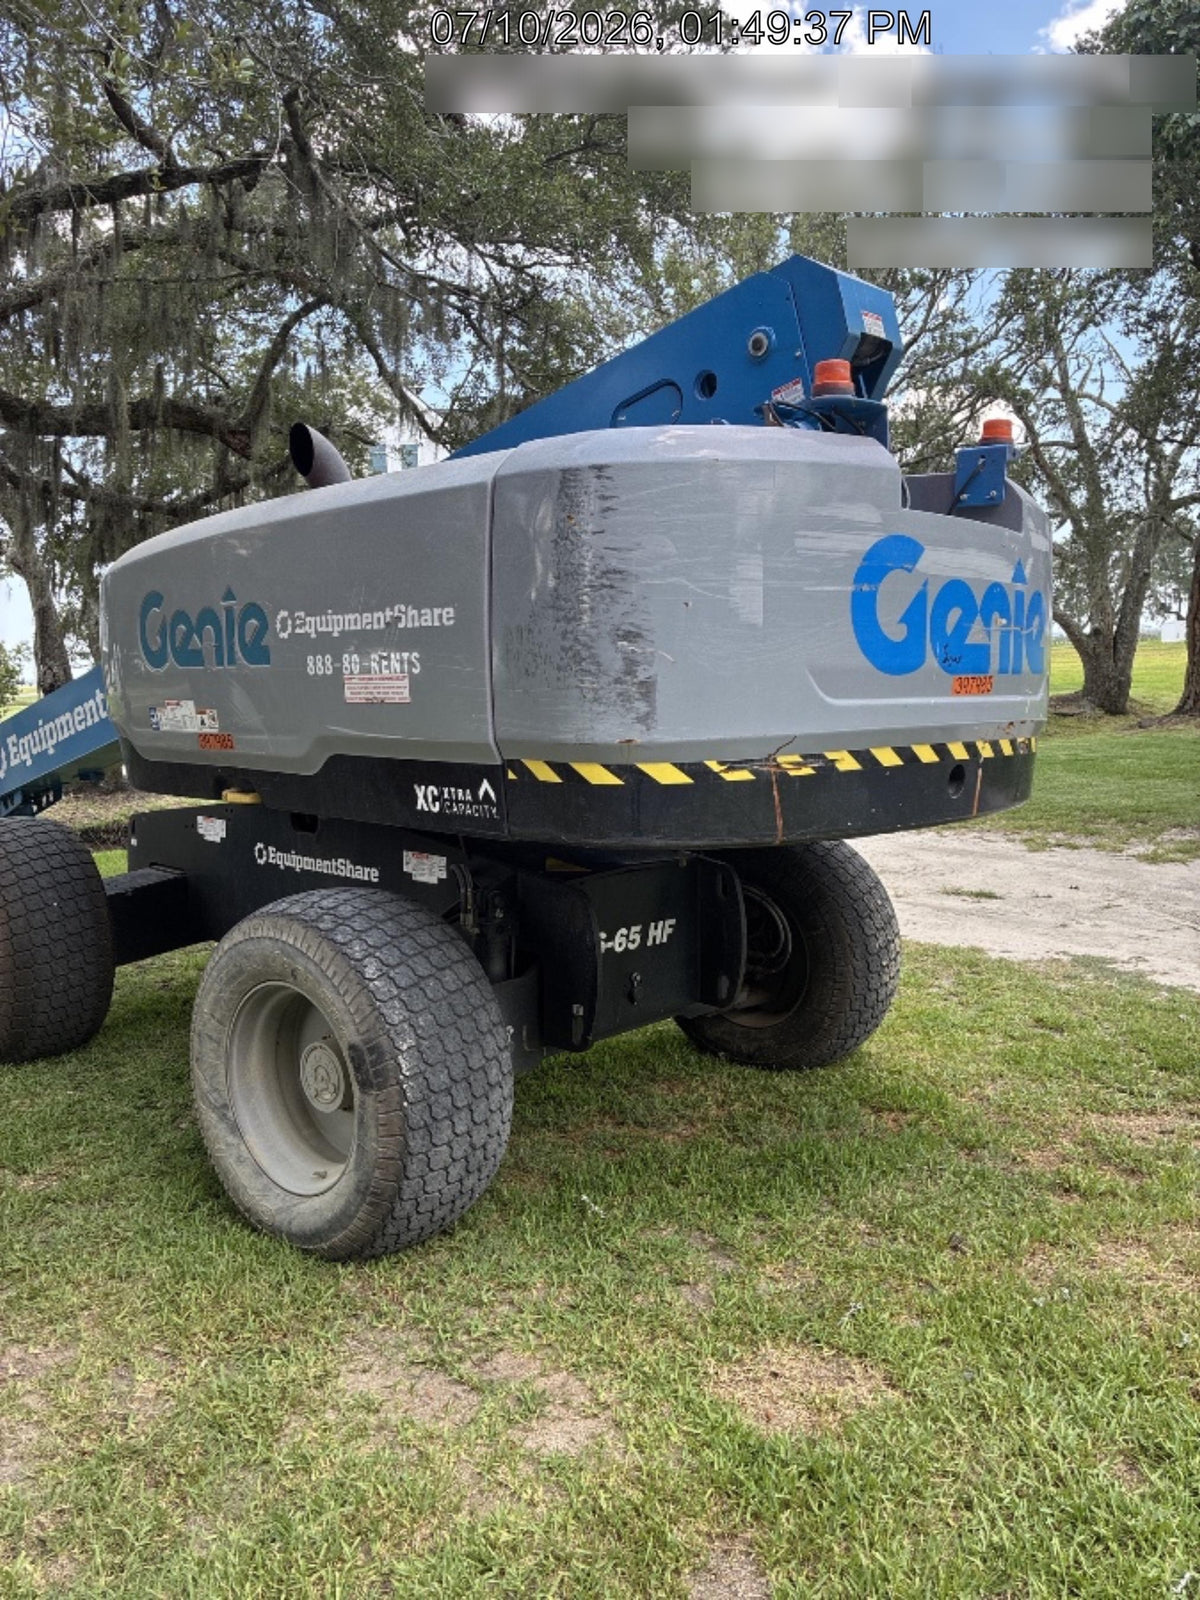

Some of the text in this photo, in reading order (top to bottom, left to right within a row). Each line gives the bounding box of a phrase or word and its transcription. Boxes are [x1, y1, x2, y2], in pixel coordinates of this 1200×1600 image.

[294, 603, 456, 638] EquipmentShare
[851, 534, 1046, 676] Genie
[138, 585, 271, 672] Genie
[306, 651, 422, 676] 888-80-RENTS
[6, 688, 109, 767] Equipment
[413, 783, 440, 814] XC
[442, 786, 473, 803] XTRA
[442, 801, 499, 820] CAPACITY
[267, 845, 380, 883] EquipmentShare
[646, 918, 677, 947] HF
